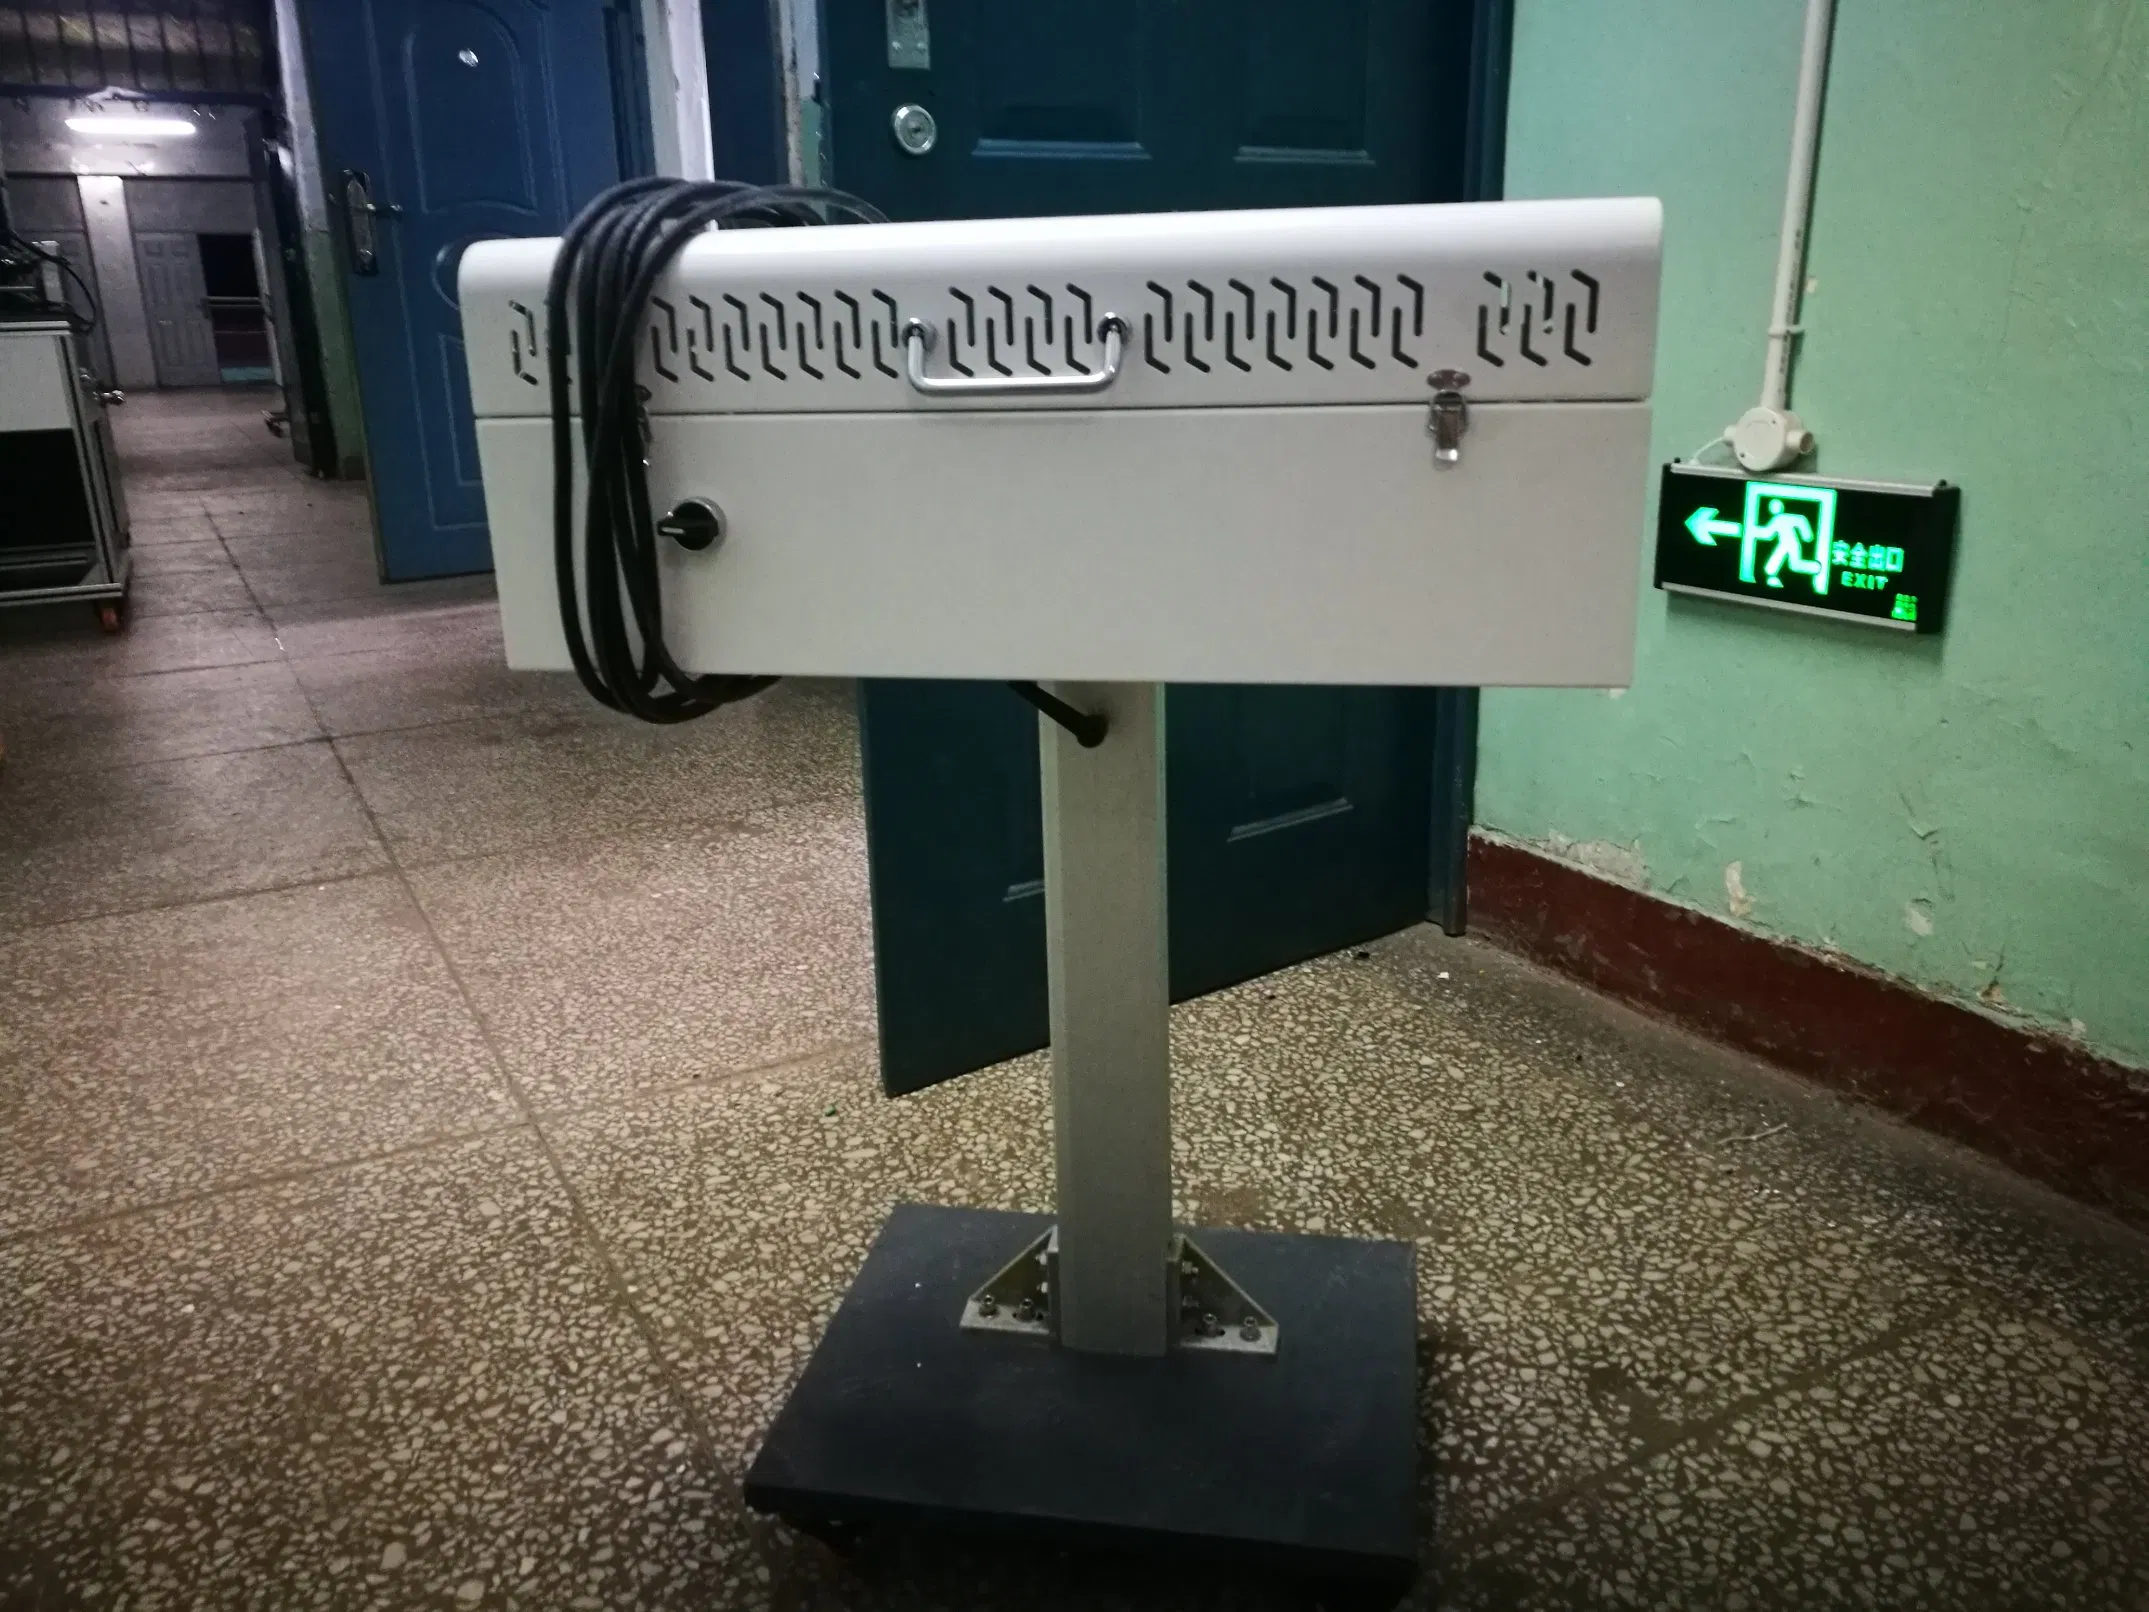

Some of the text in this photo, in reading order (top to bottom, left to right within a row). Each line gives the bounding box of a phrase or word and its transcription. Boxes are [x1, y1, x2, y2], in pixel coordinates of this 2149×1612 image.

[1832, 540, 1904, 572] 安全出口
[1841, 571, 1888, 590] EXIT
